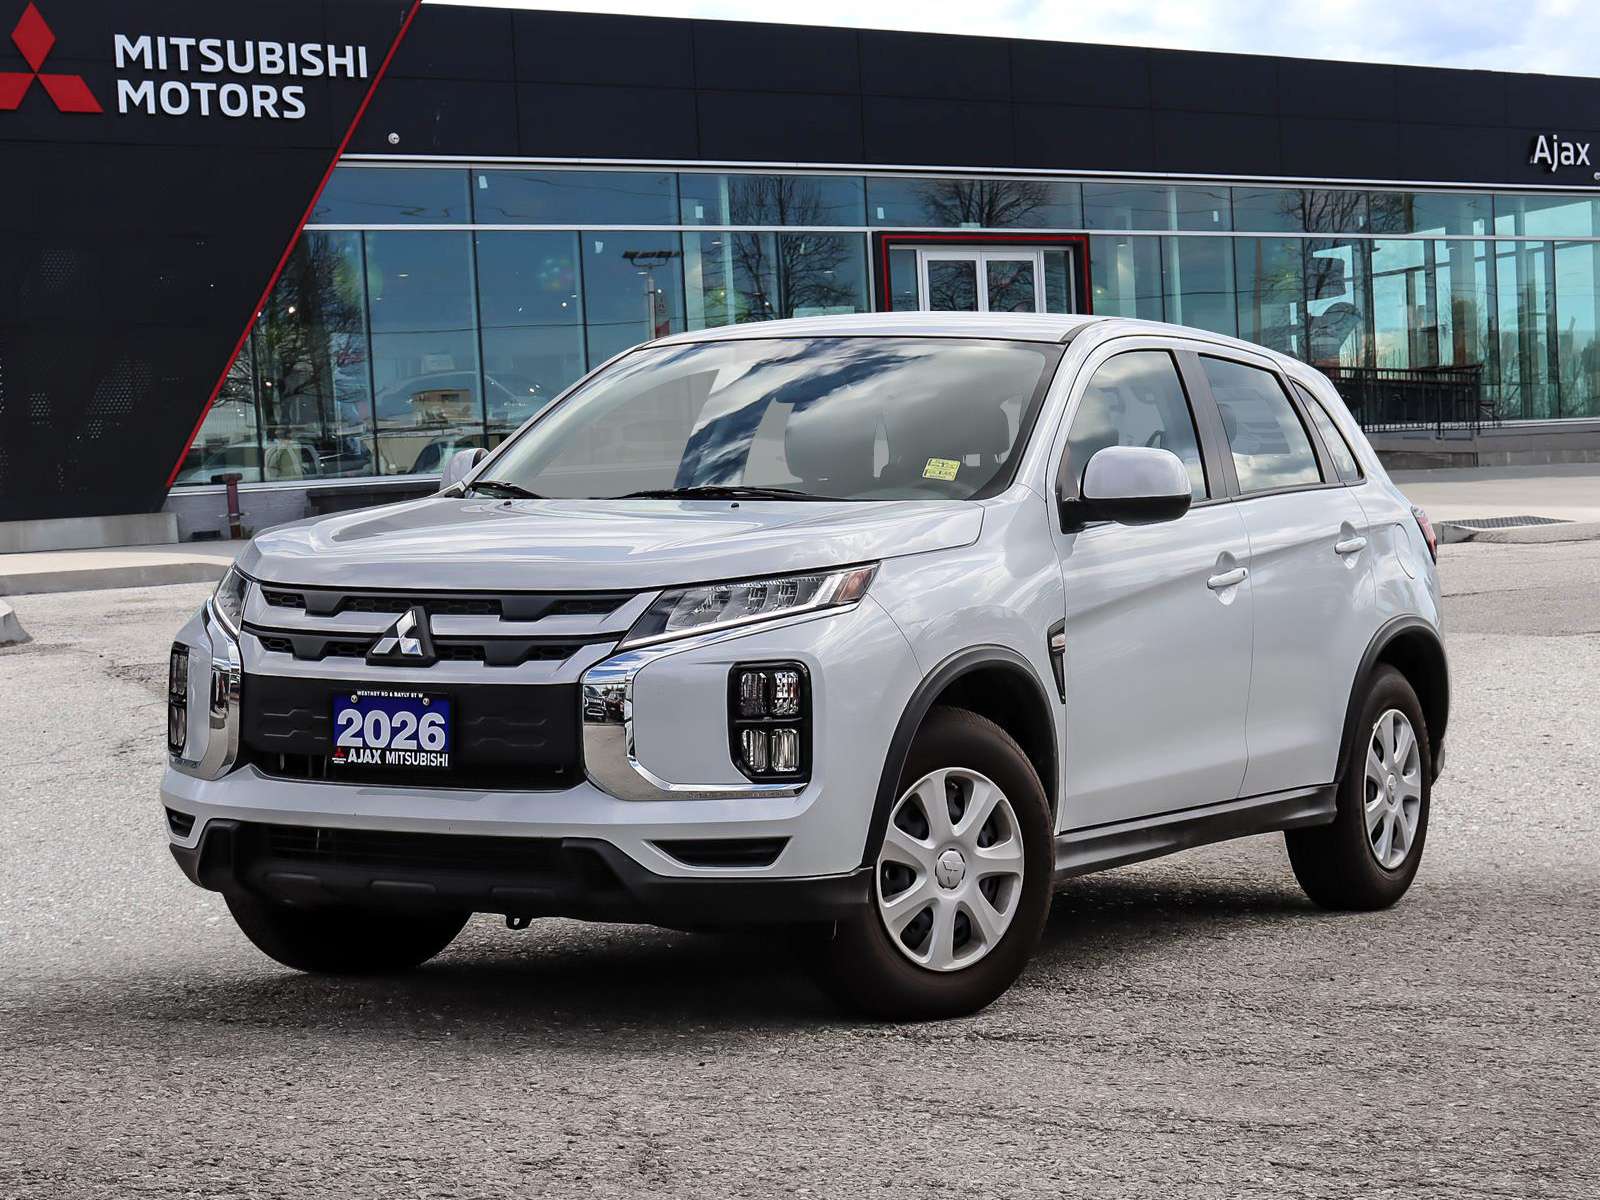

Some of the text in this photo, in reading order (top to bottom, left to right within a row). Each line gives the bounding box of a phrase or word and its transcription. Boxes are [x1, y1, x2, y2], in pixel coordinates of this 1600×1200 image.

[114, 33, 368, 78] MITSUBISHI
[117, 79, 306, 119] MOTORS
[1533, 134, 1591, 172] Ajax
[337, 708, 446, 751] 2026
[347, 748, 382, 764] AJAX
[385, 750, 449, 767] MITSUBISHI
